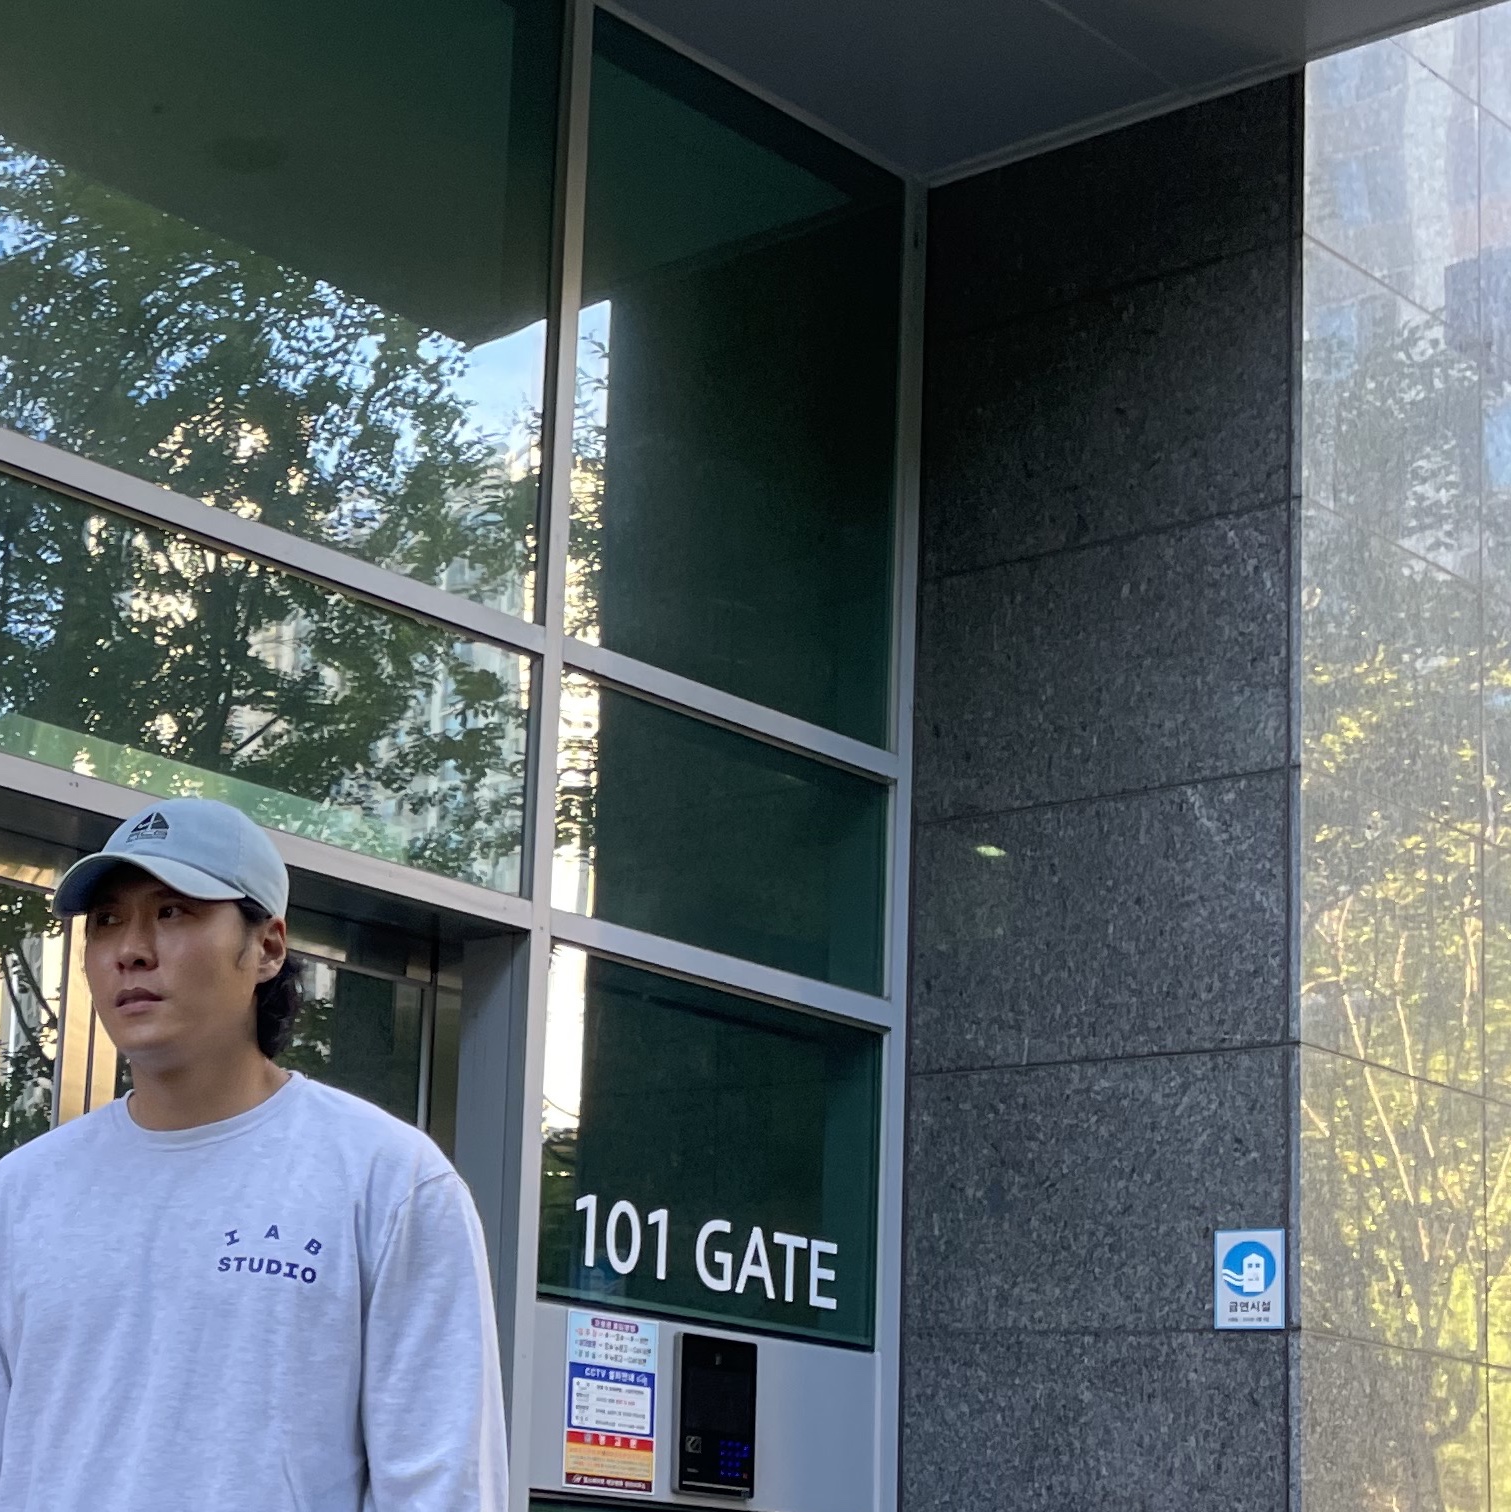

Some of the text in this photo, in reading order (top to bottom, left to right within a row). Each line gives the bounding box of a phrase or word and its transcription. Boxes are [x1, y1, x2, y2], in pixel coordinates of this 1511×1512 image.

[575, 1194, 838, 1310] 101 GATE
[217, 1256, 317, 1284] STUDIO
[1229, 1301, 1271, 1312] 금연시설
